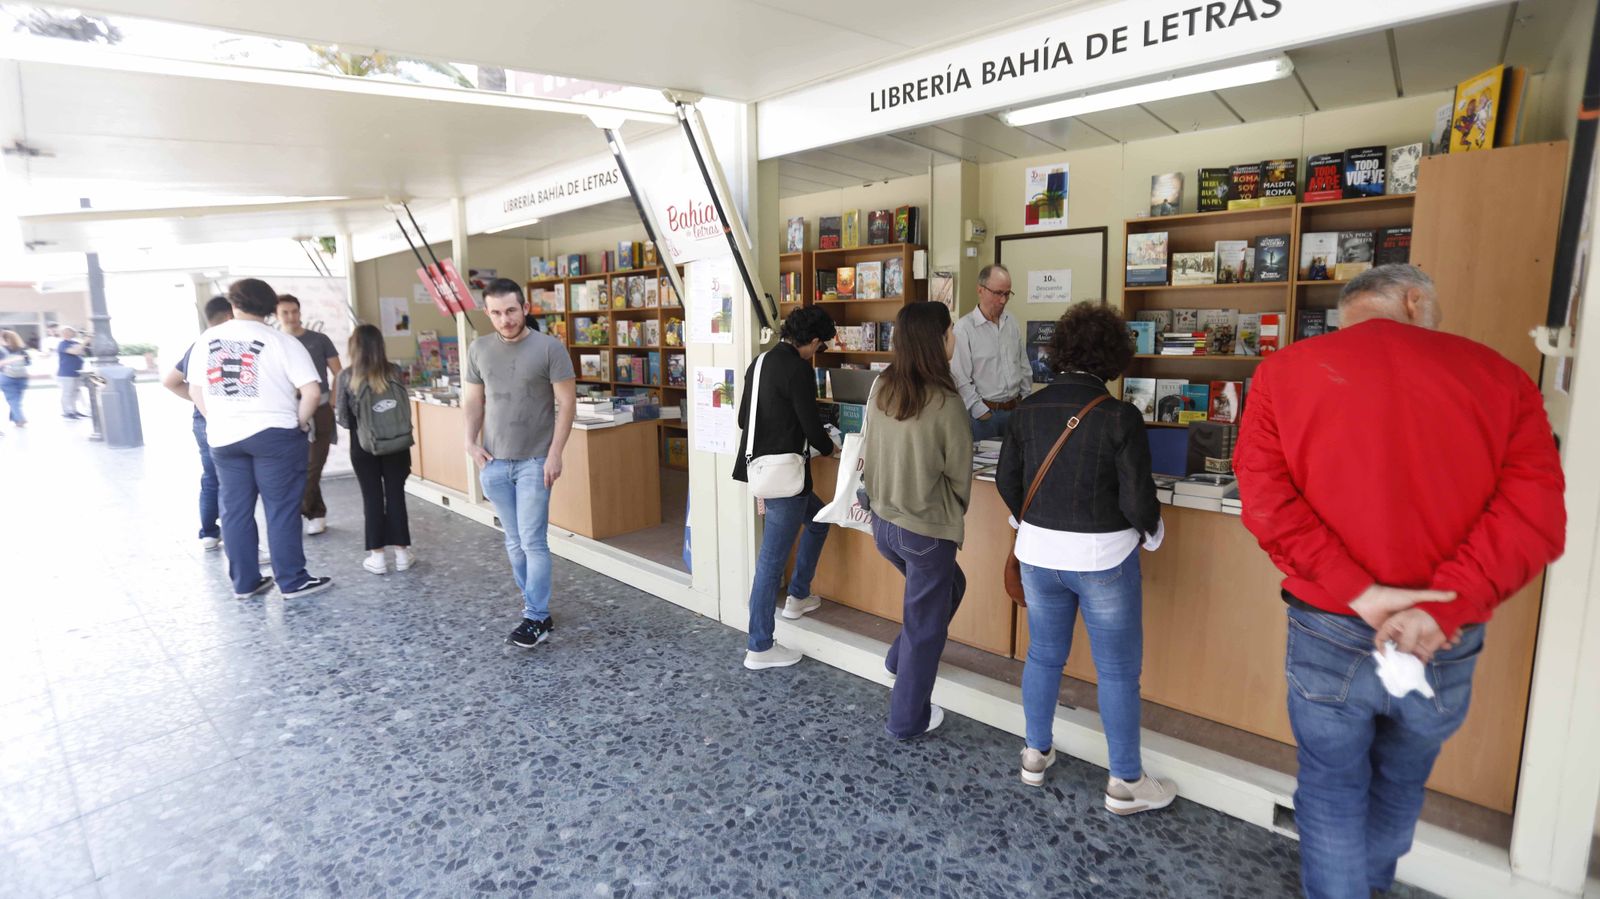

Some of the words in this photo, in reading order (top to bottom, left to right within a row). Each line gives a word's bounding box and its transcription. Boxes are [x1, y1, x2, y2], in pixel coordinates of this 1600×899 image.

[869, 64, 972, 113] LIBRERÍA
[981, 37, 1074, 85] BAHÍA
[1086, 25, 1129, 61] DE
[1142, 0, 1283, 47] LETRAS
[1354, 159, 1379, 171] TODO
[1232, 175, 1260, 184] ROMA
[1346, 168, 1386, 186] VUELVE
[503, 190, 536, 214] LIBRERÍA
[538, 180, 565, 204] BAHÍA
[567, 180, 581, 196] DE
[583, 168, 619, 192] LETRAS
[1238, 183, 1255, 192] SOY
[1263, 180, 1296, 189] MALDITA
[1265, 188, 1293, 197] ROMA
[667, 200, 717, 231] Bahía
[692, 223, 720, 239] letras
